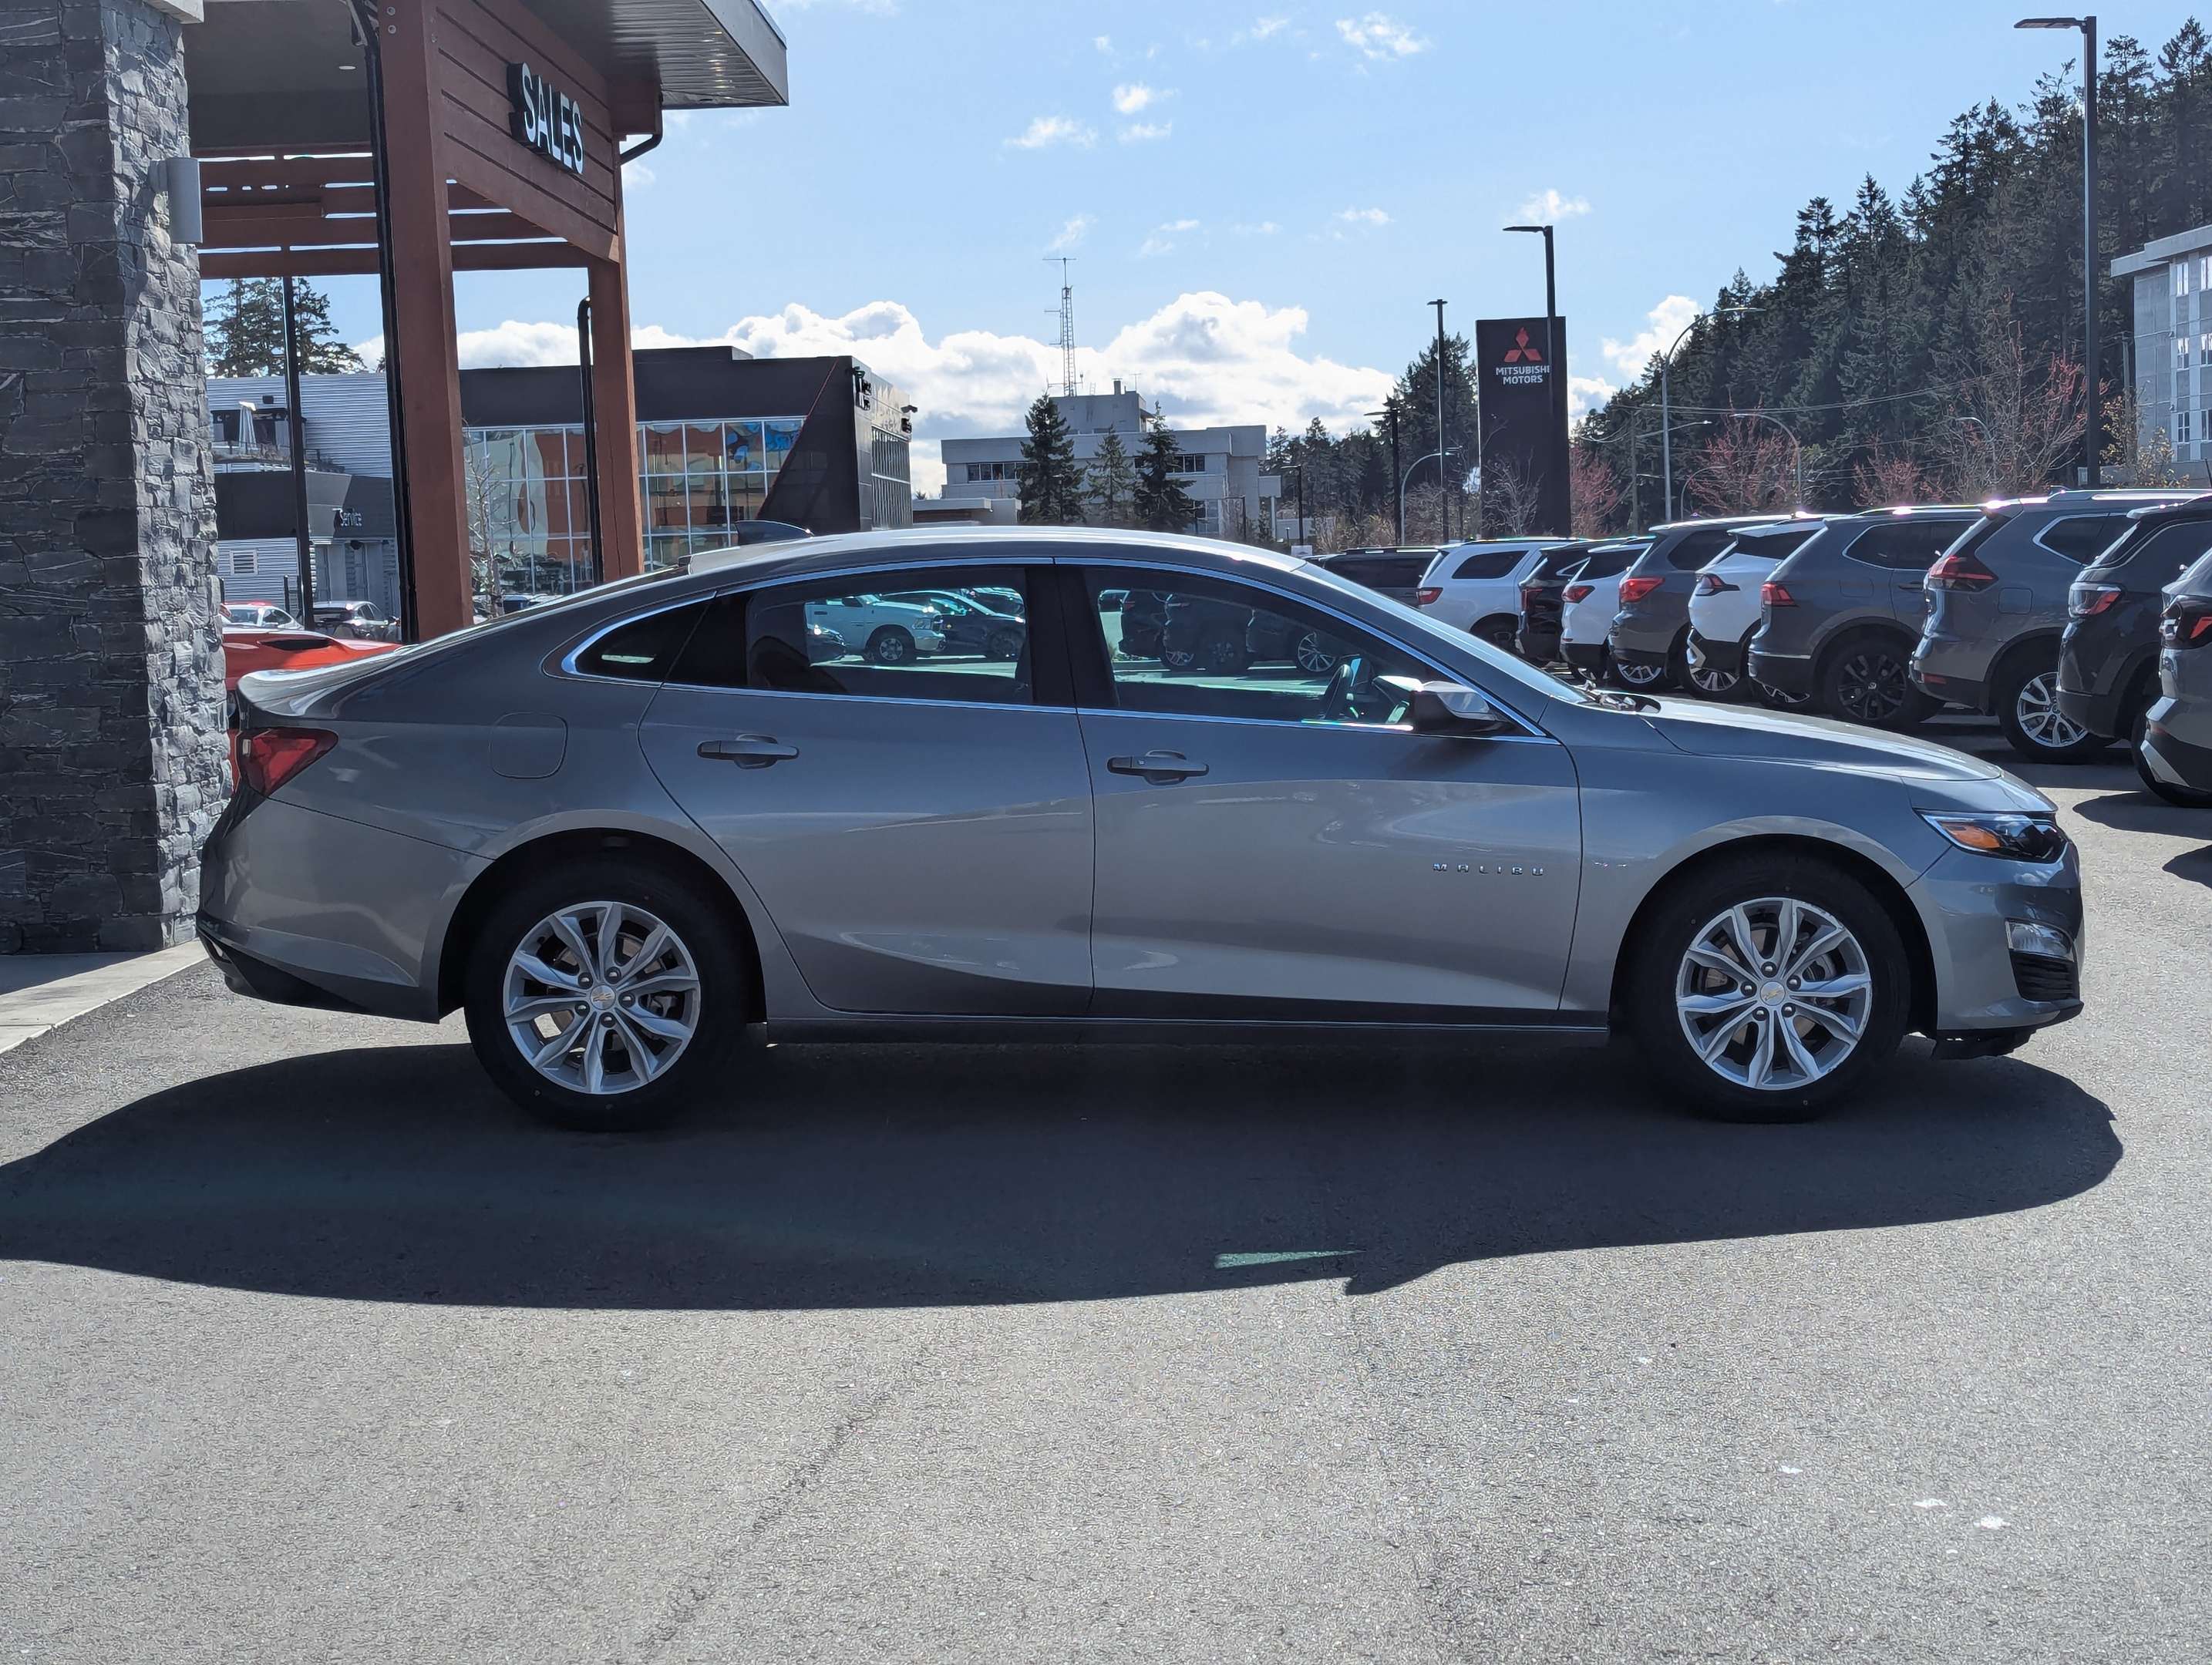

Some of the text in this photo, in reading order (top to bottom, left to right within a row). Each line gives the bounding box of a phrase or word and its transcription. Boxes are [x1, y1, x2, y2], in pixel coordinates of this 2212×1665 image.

[520, 62, 584, 174] SALES
[1495, 365, 1550, 376] MITSUBISHI
[1503, 375, 1544, 385] MOTORS
[1433, 863, 1544, 876] MALIBU
